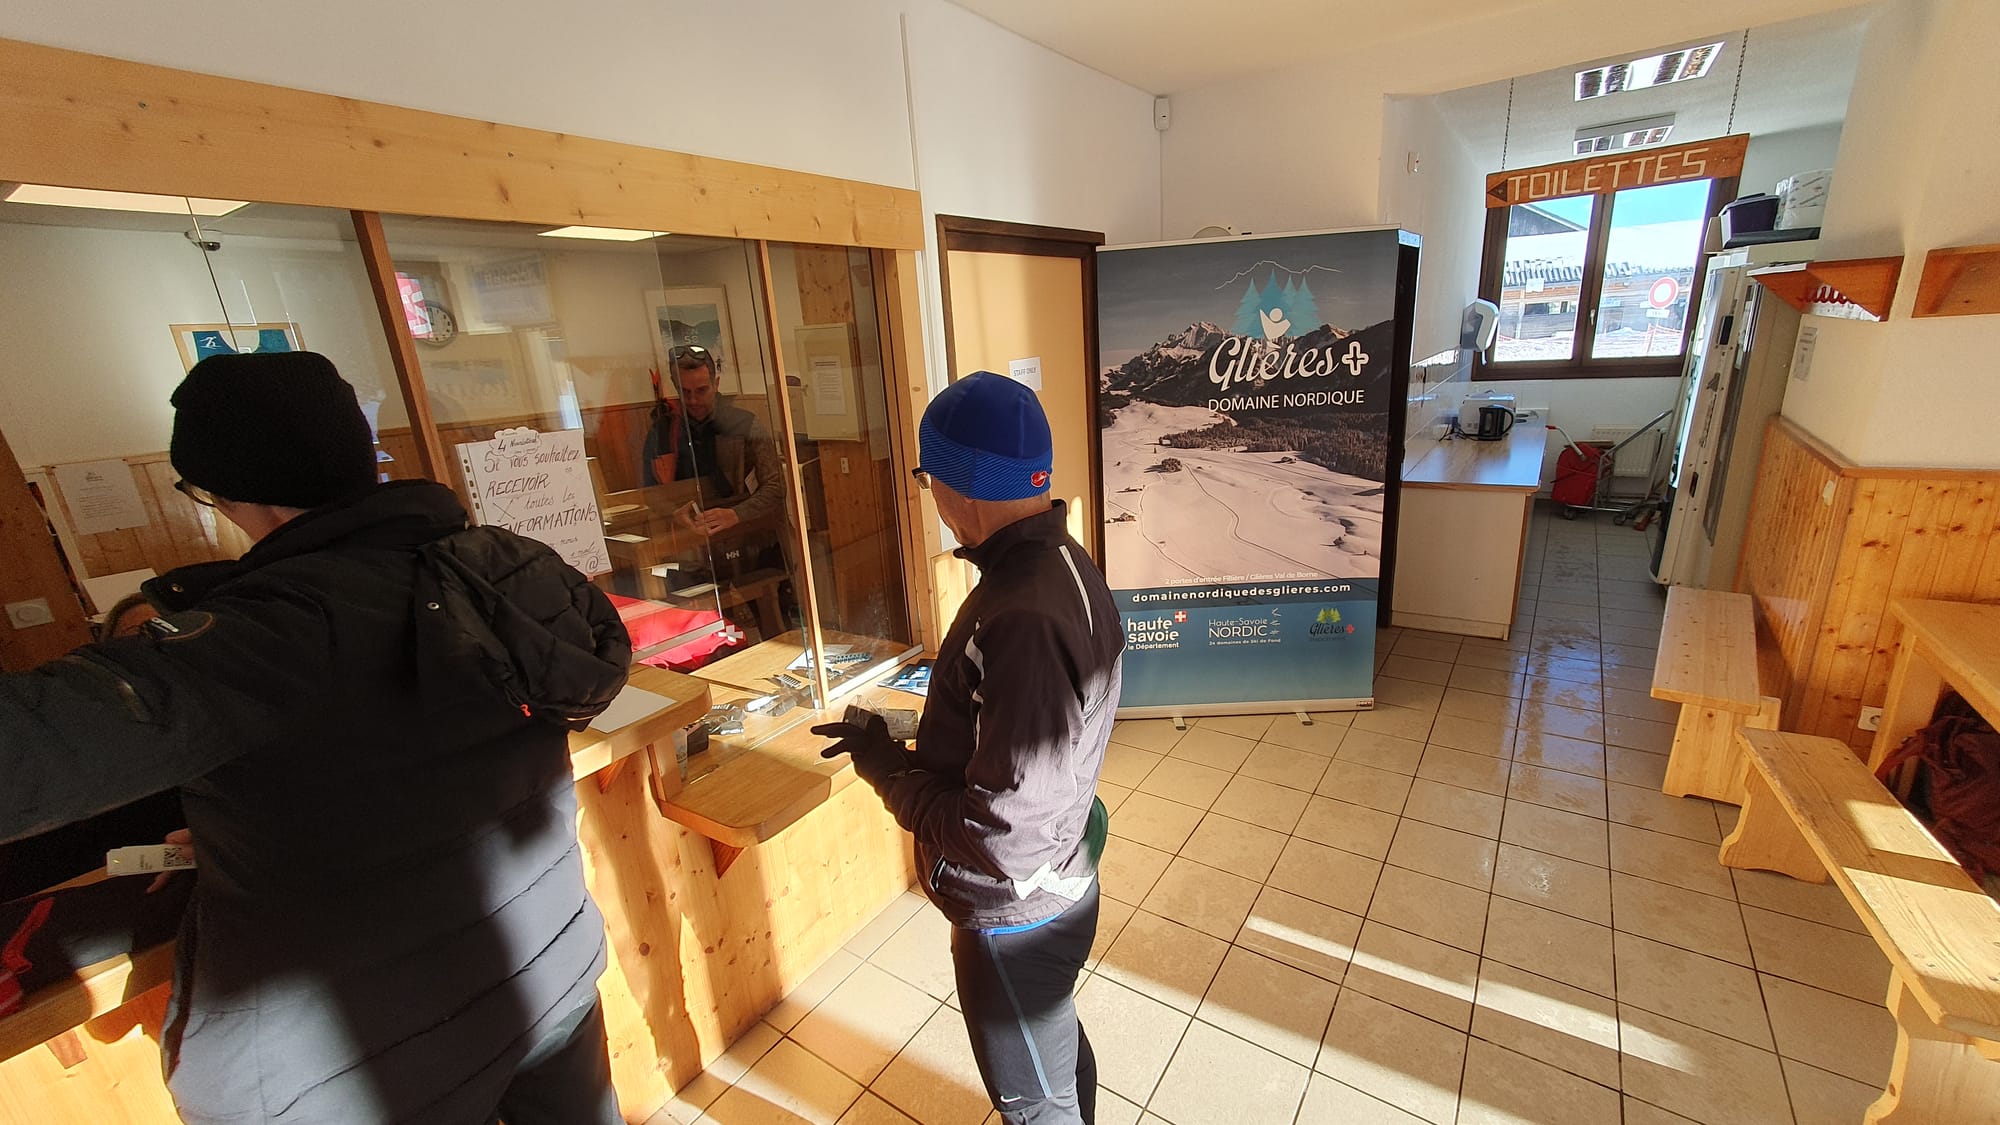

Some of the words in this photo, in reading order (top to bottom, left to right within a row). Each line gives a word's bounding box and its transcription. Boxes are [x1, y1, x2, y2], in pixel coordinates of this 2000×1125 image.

[1507, 147, 1710, 201] TOILETTES
[1208, 395, 1280, 412] DOMAINE
[1283, 390, 1365, 408] NORDIQUE
[486, 473, 551, 499] RECEVOIR
[1170, 576, 1193, 586] portes
[1193, 575, 1222, 583] d'entrée
[1274, 571, 1286, 579] Val
[1132, 583, 1351, 603] domainenordiquedesglieres.com
[1127, 616, 1173, 632] haute
[1208, 617, 1268, 627] Haute-Savoie
[1128, 630, 1179, 643] savoie
[1208, 625, 1268, 638] NORDIC
[1135, 641, 1180, 650] Département
